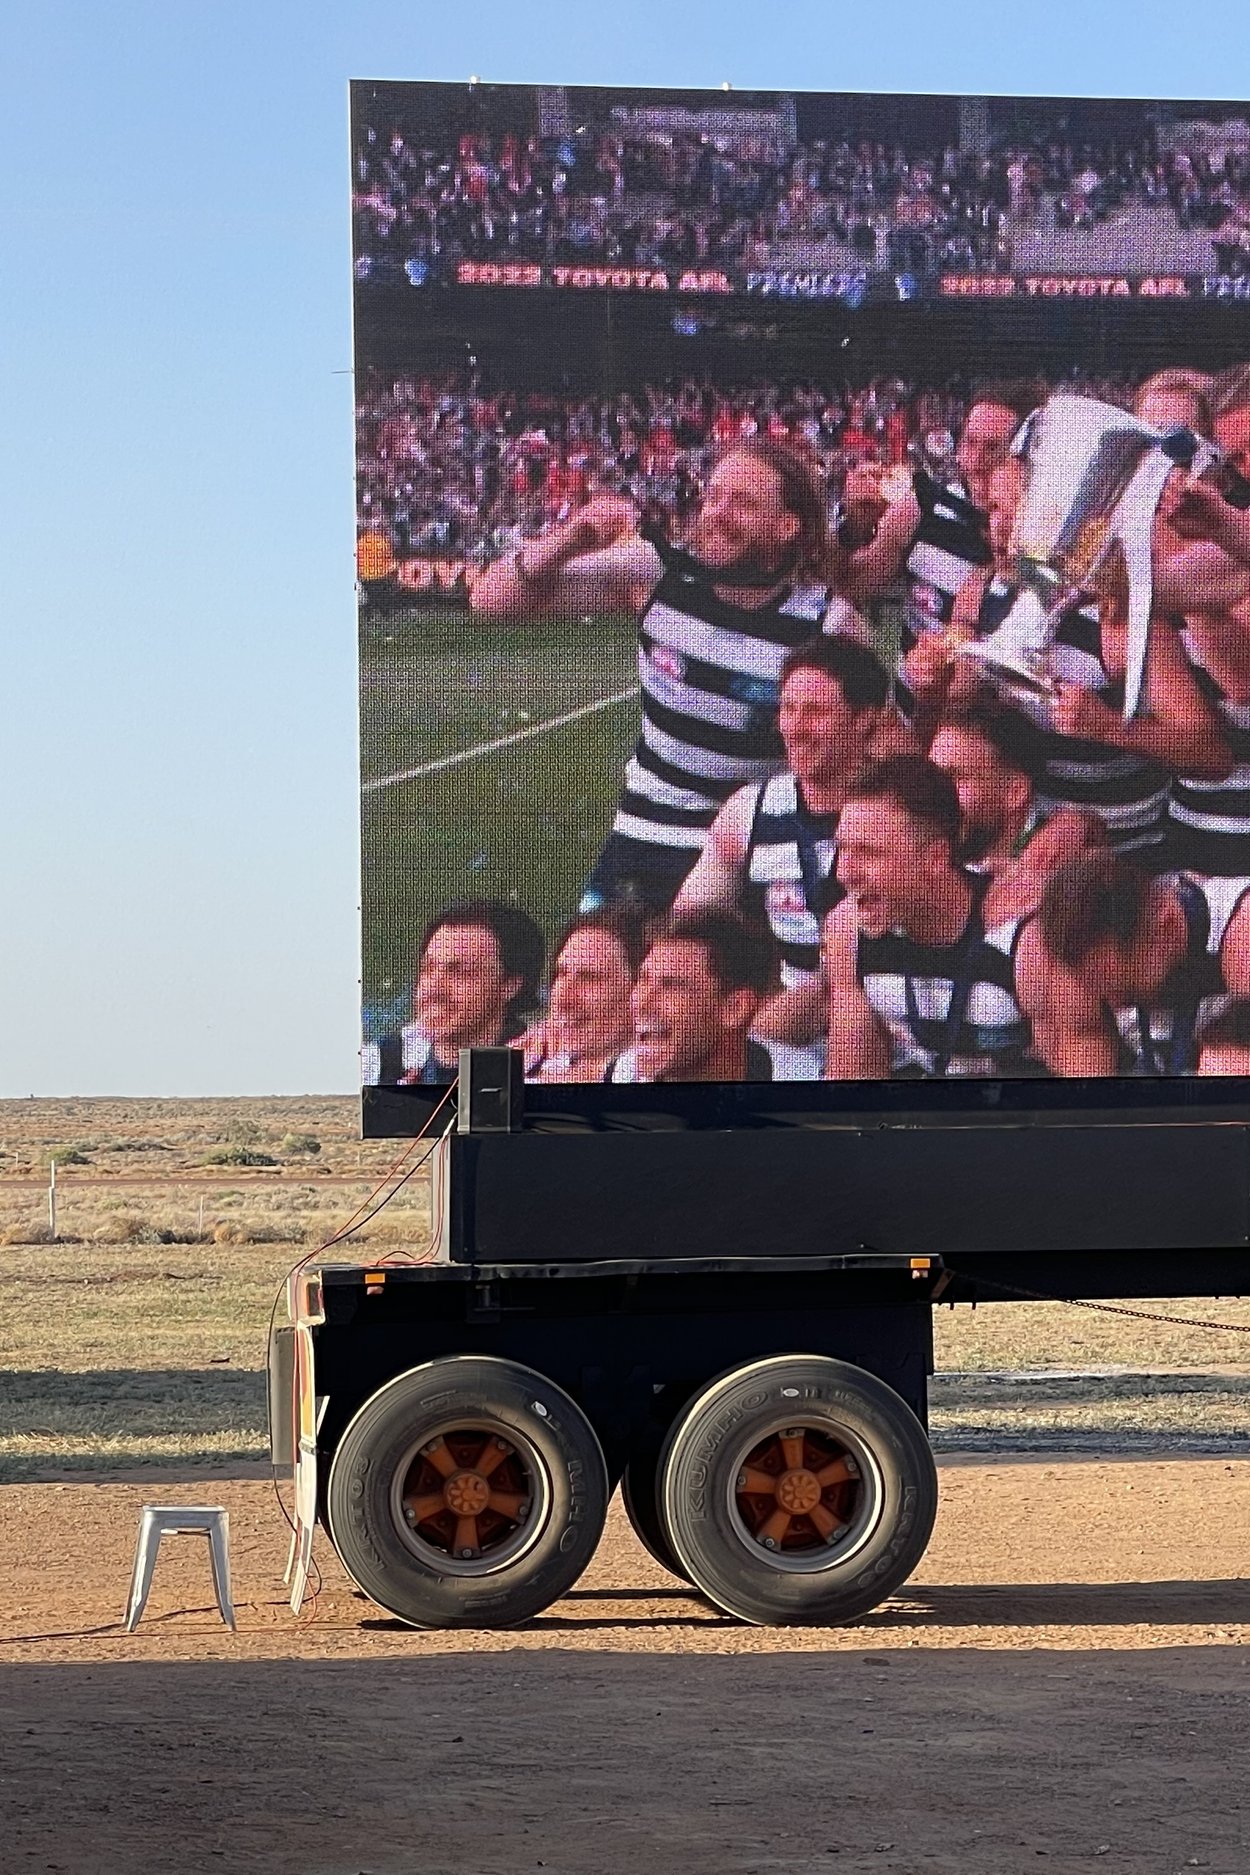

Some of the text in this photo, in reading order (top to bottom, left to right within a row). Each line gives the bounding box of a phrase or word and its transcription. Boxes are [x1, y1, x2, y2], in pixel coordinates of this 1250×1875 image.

[553, 266, 670, 289] TOYOTA
[1025, 276, 1130, 297] TOYOTA
[690, 1391, 768, 1523] KUMHO
